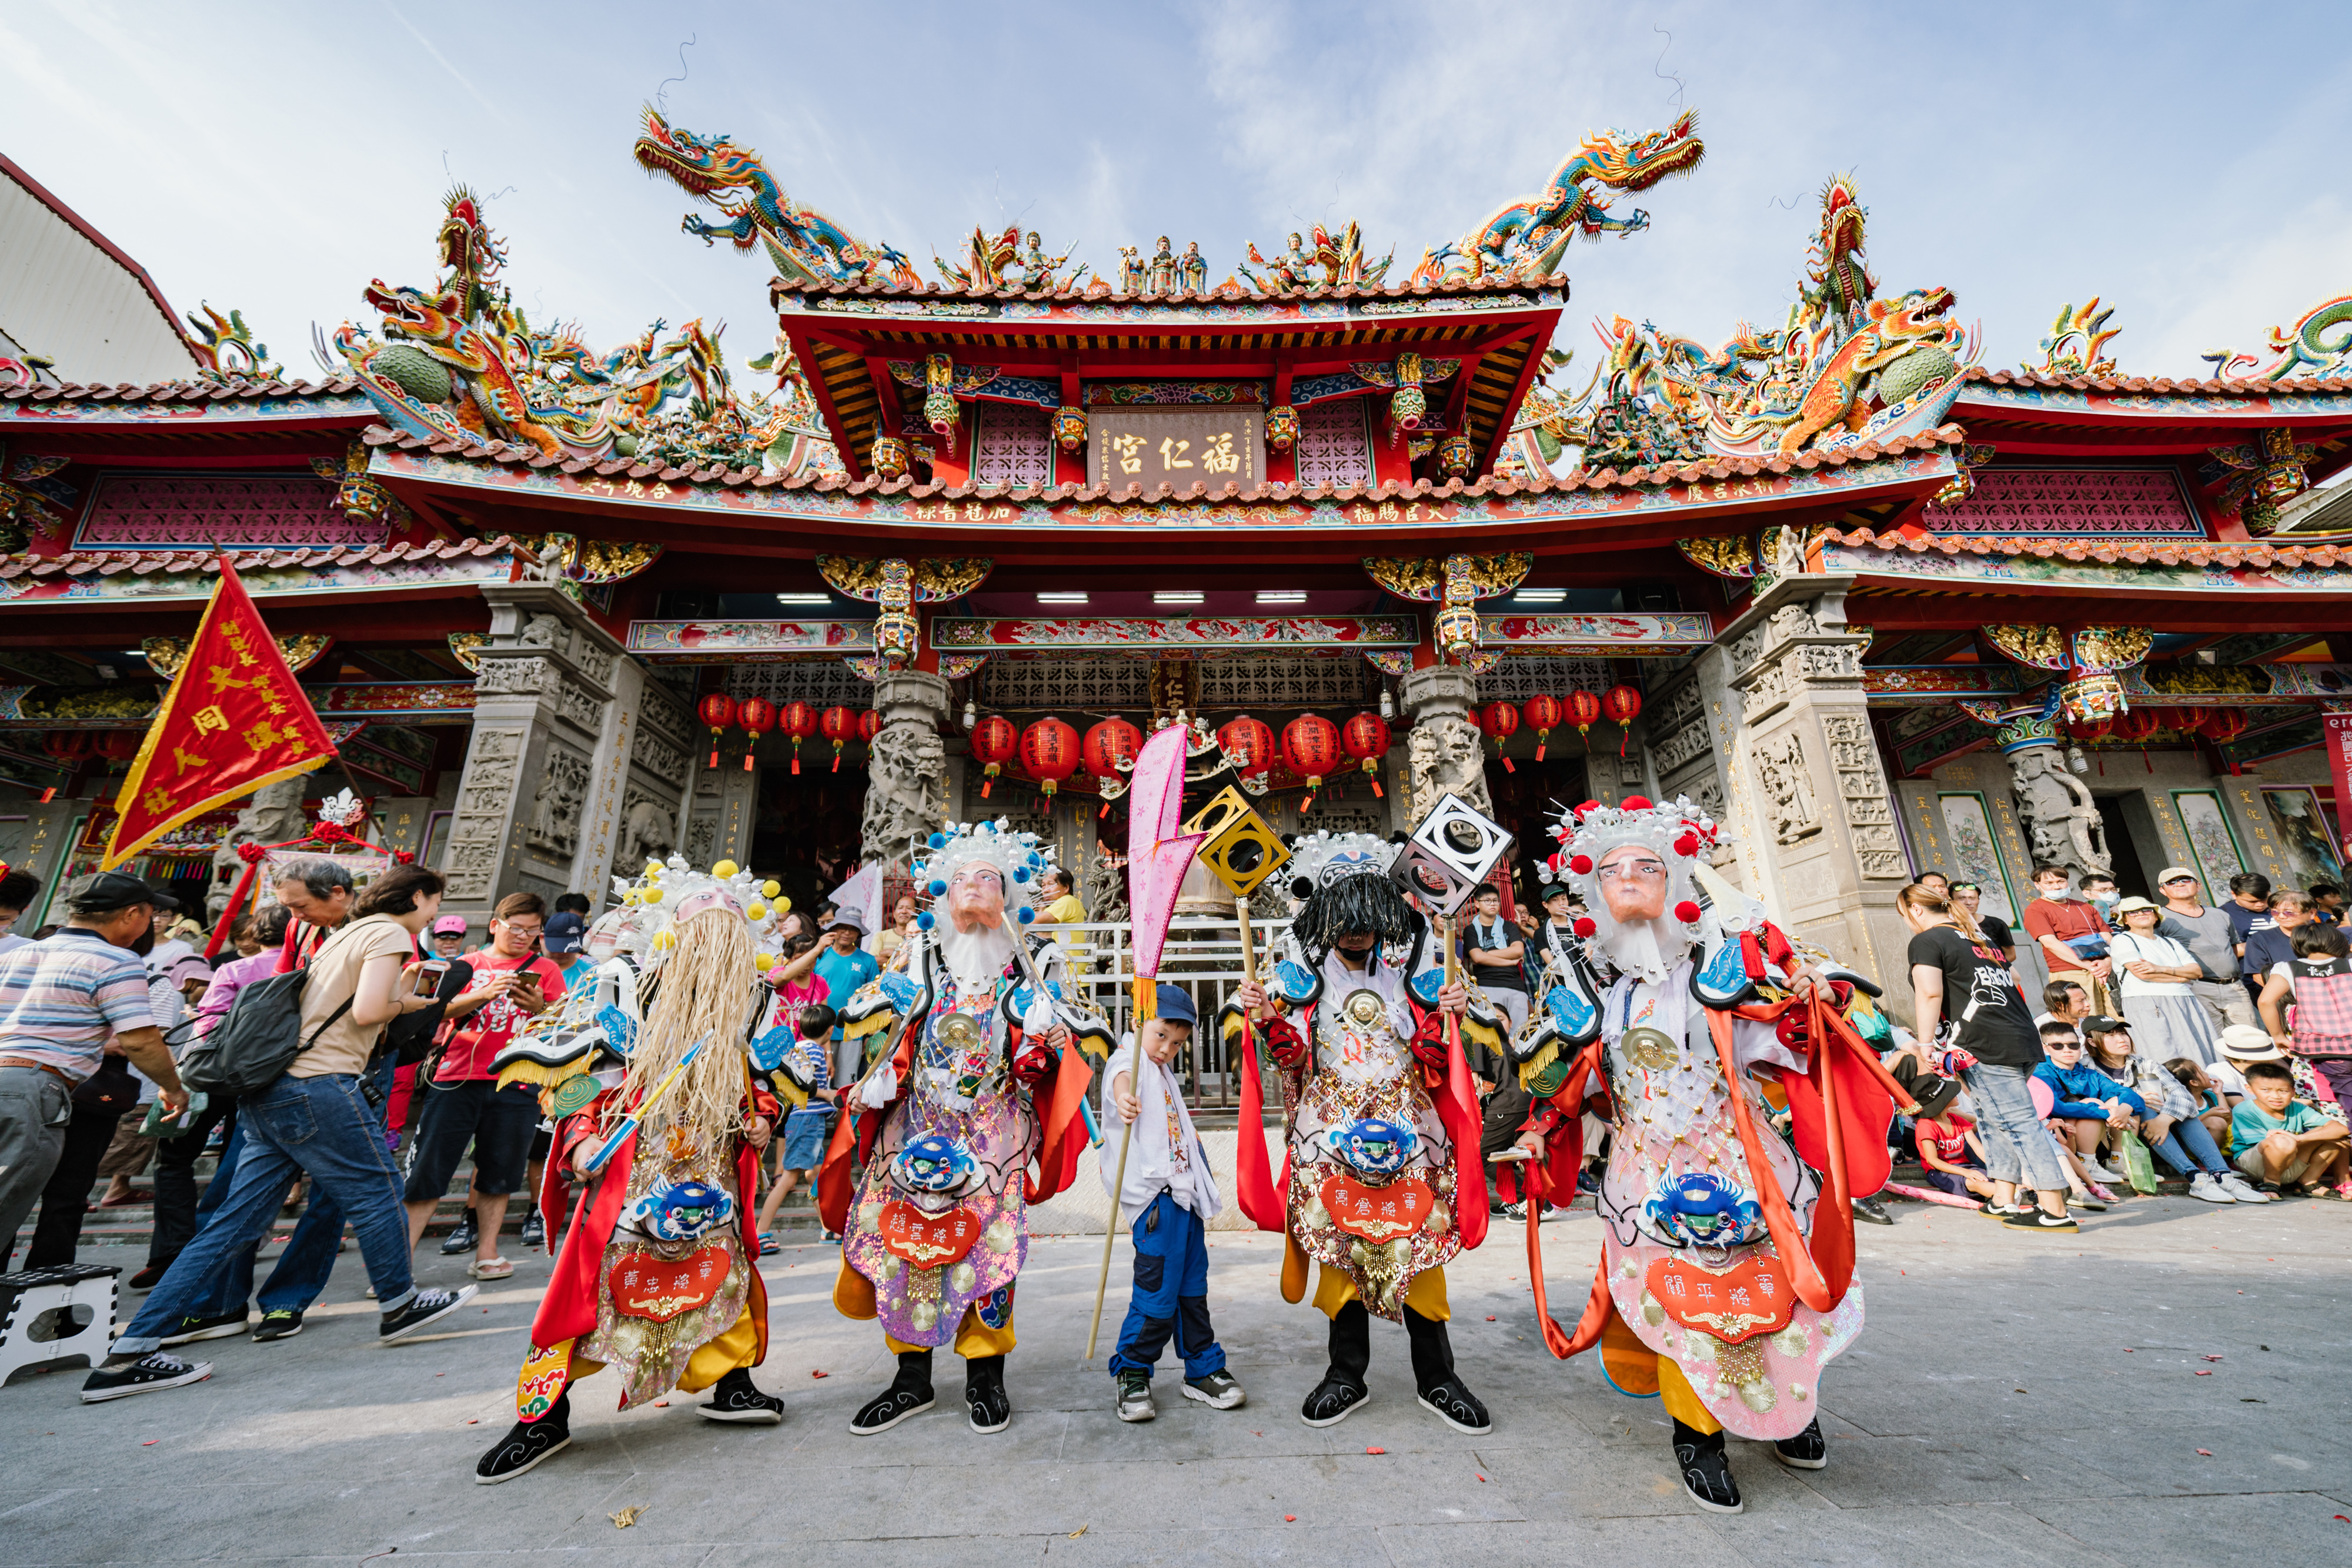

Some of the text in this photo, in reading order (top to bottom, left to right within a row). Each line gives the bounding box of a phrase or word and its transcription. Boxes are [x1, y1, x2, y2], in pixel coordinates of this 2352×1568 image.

[1047, 725, 1058, 764] 風調雨順
[1098, 729, 1112, 768] 國泰民安
[1307, 727, 1322, 763] 開漳聖王
[1365, 718, 1378, 753] 開漳聖王
[1335, 1189, 1416, 1218] 周倉將軍
[889, 1212, 967, 1243] 趙雲將軍
[623, 1260, 713, 1294] 黃忠將軍
